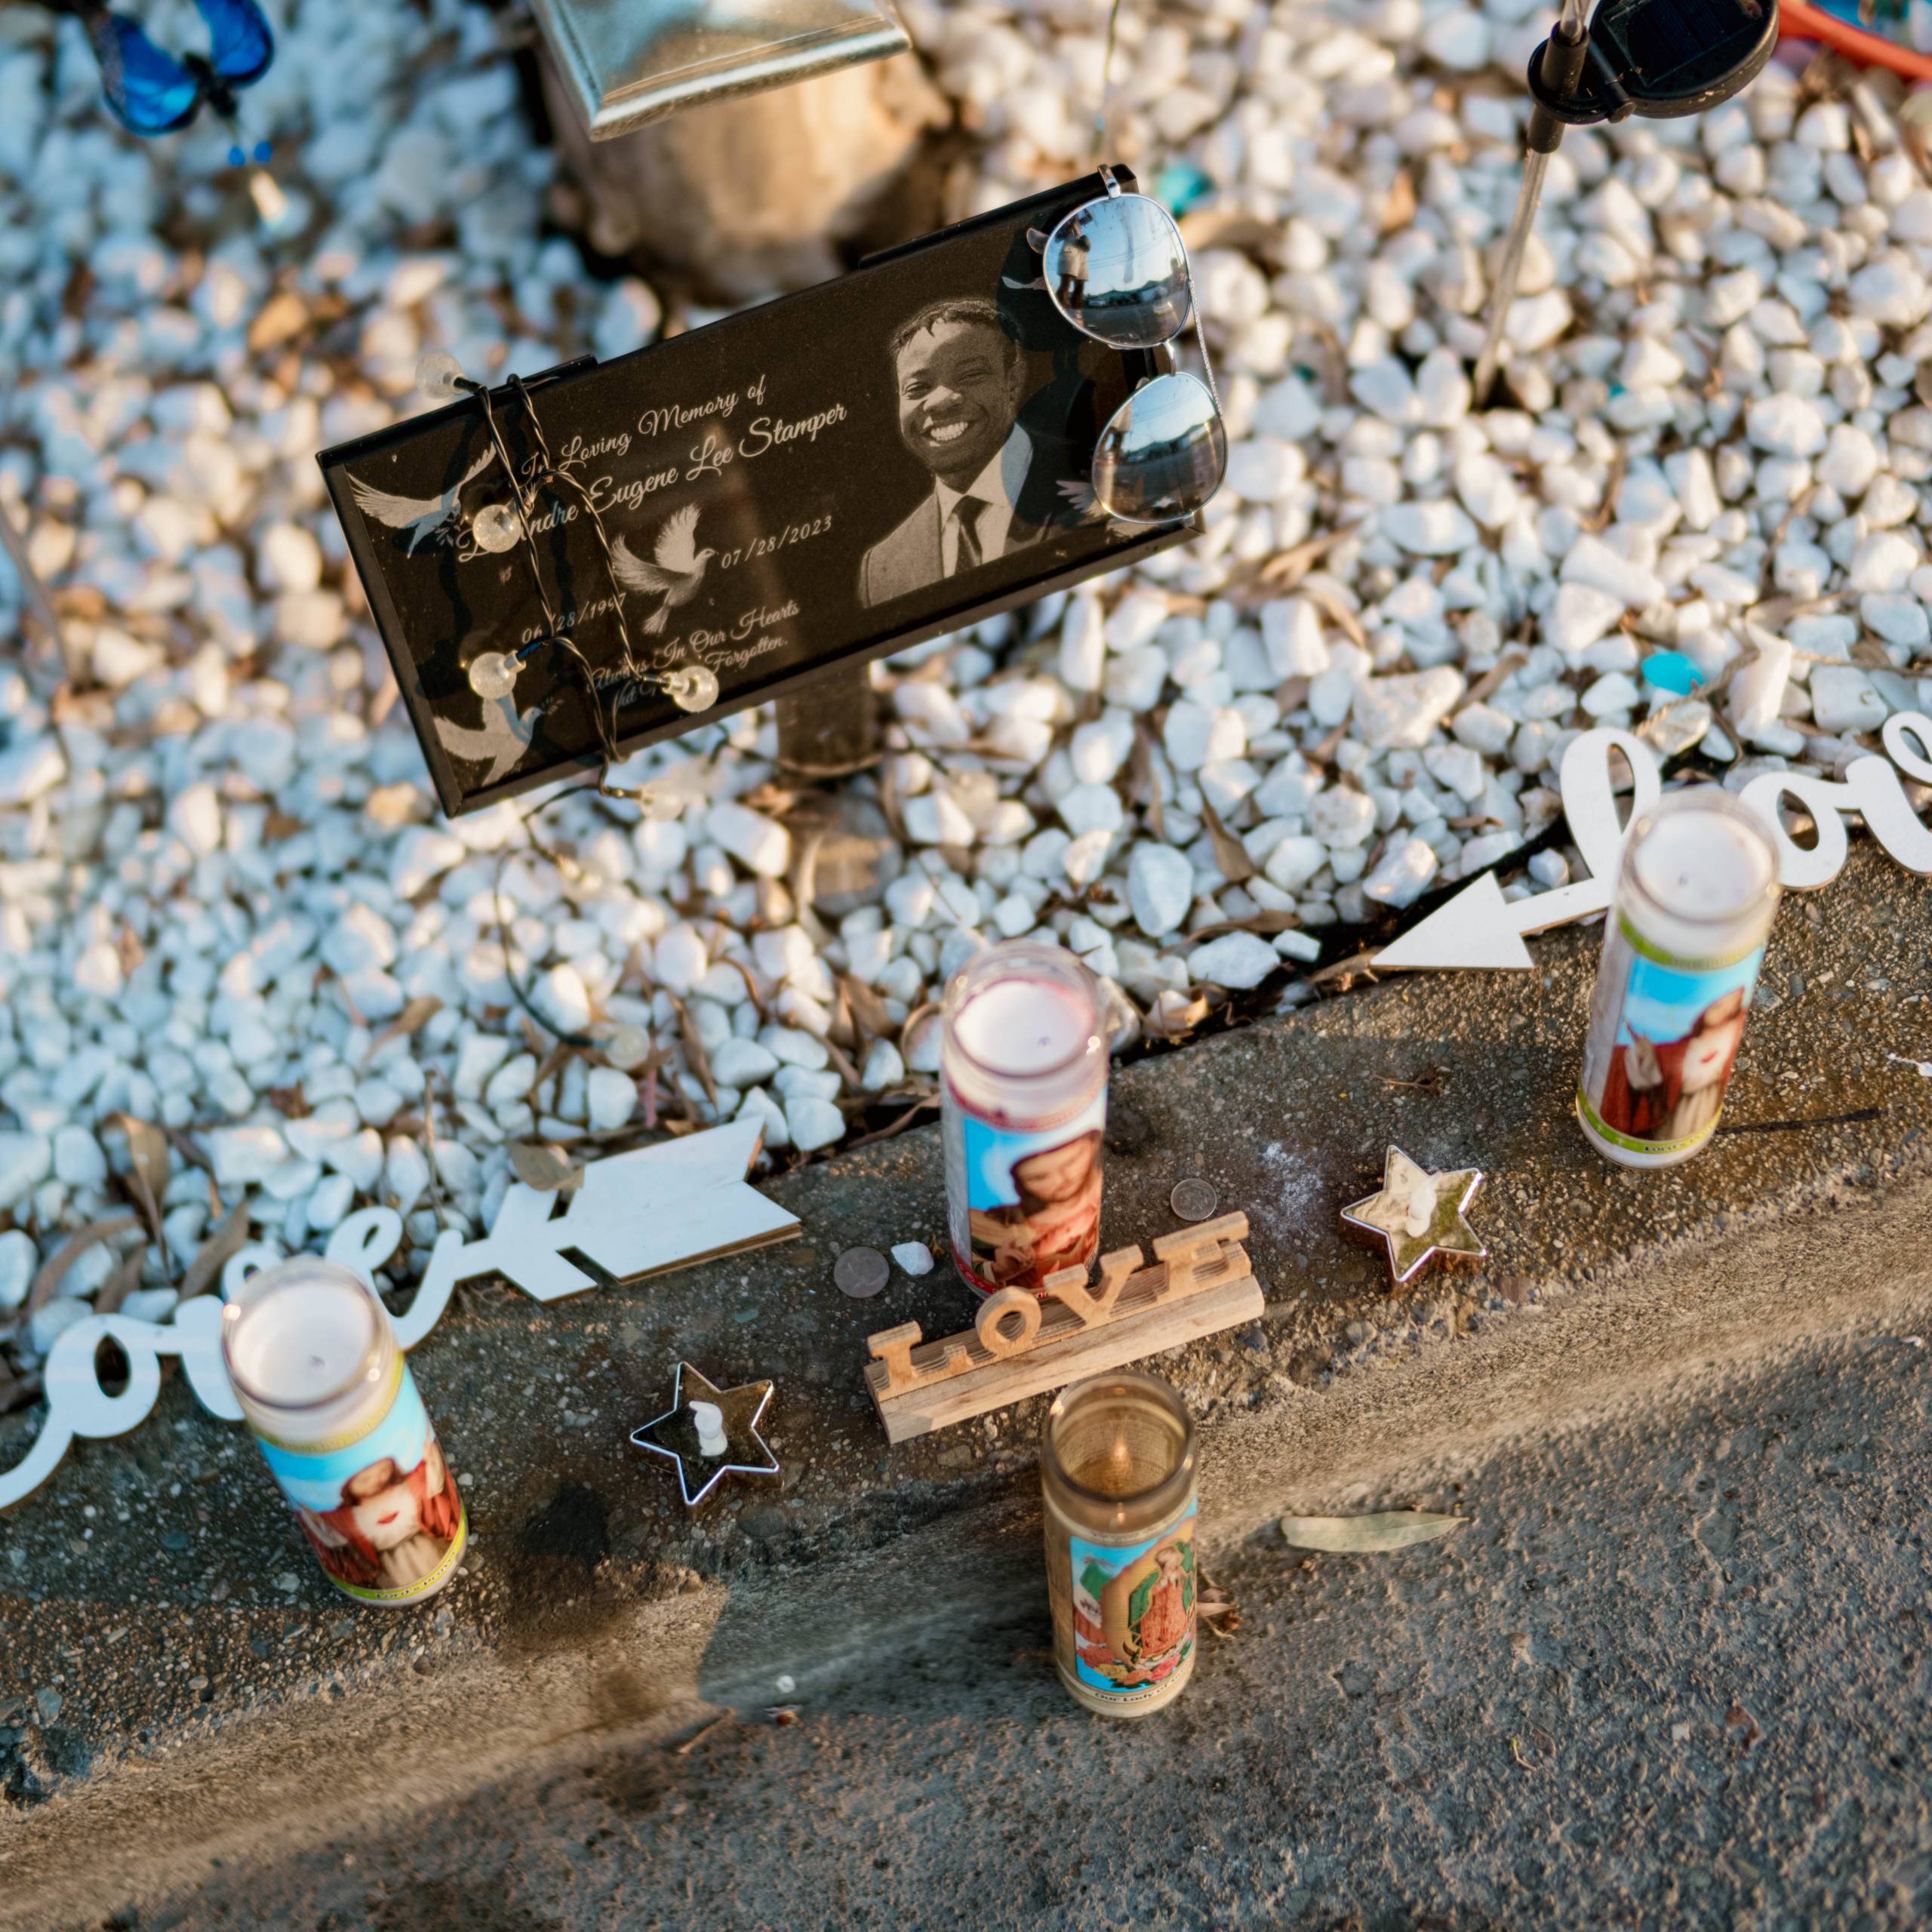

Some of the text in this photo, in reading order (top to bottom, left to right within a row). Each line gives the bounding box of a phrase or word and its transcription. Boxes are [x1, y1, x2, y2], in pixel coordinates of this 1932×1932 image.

[559, 435, 632, 477] Loving
[638, 405, 739, 436] Memory
[747, 374, 766, 405] of
[585, 468, 678, 514] Eugene
[686, 435, 734, 481] Lee
[739, 404, 848, 457] Stamper
[721, 515, 832, 568] 07/28/2023
[653, 638, 687, 669] In
[689, 630, 727, 653] Our
[730, 600, 800, 641] Hearts
[705, 635, 788, 674] Forgotten.
[867, 1211, 1251, 1399] LOVE
